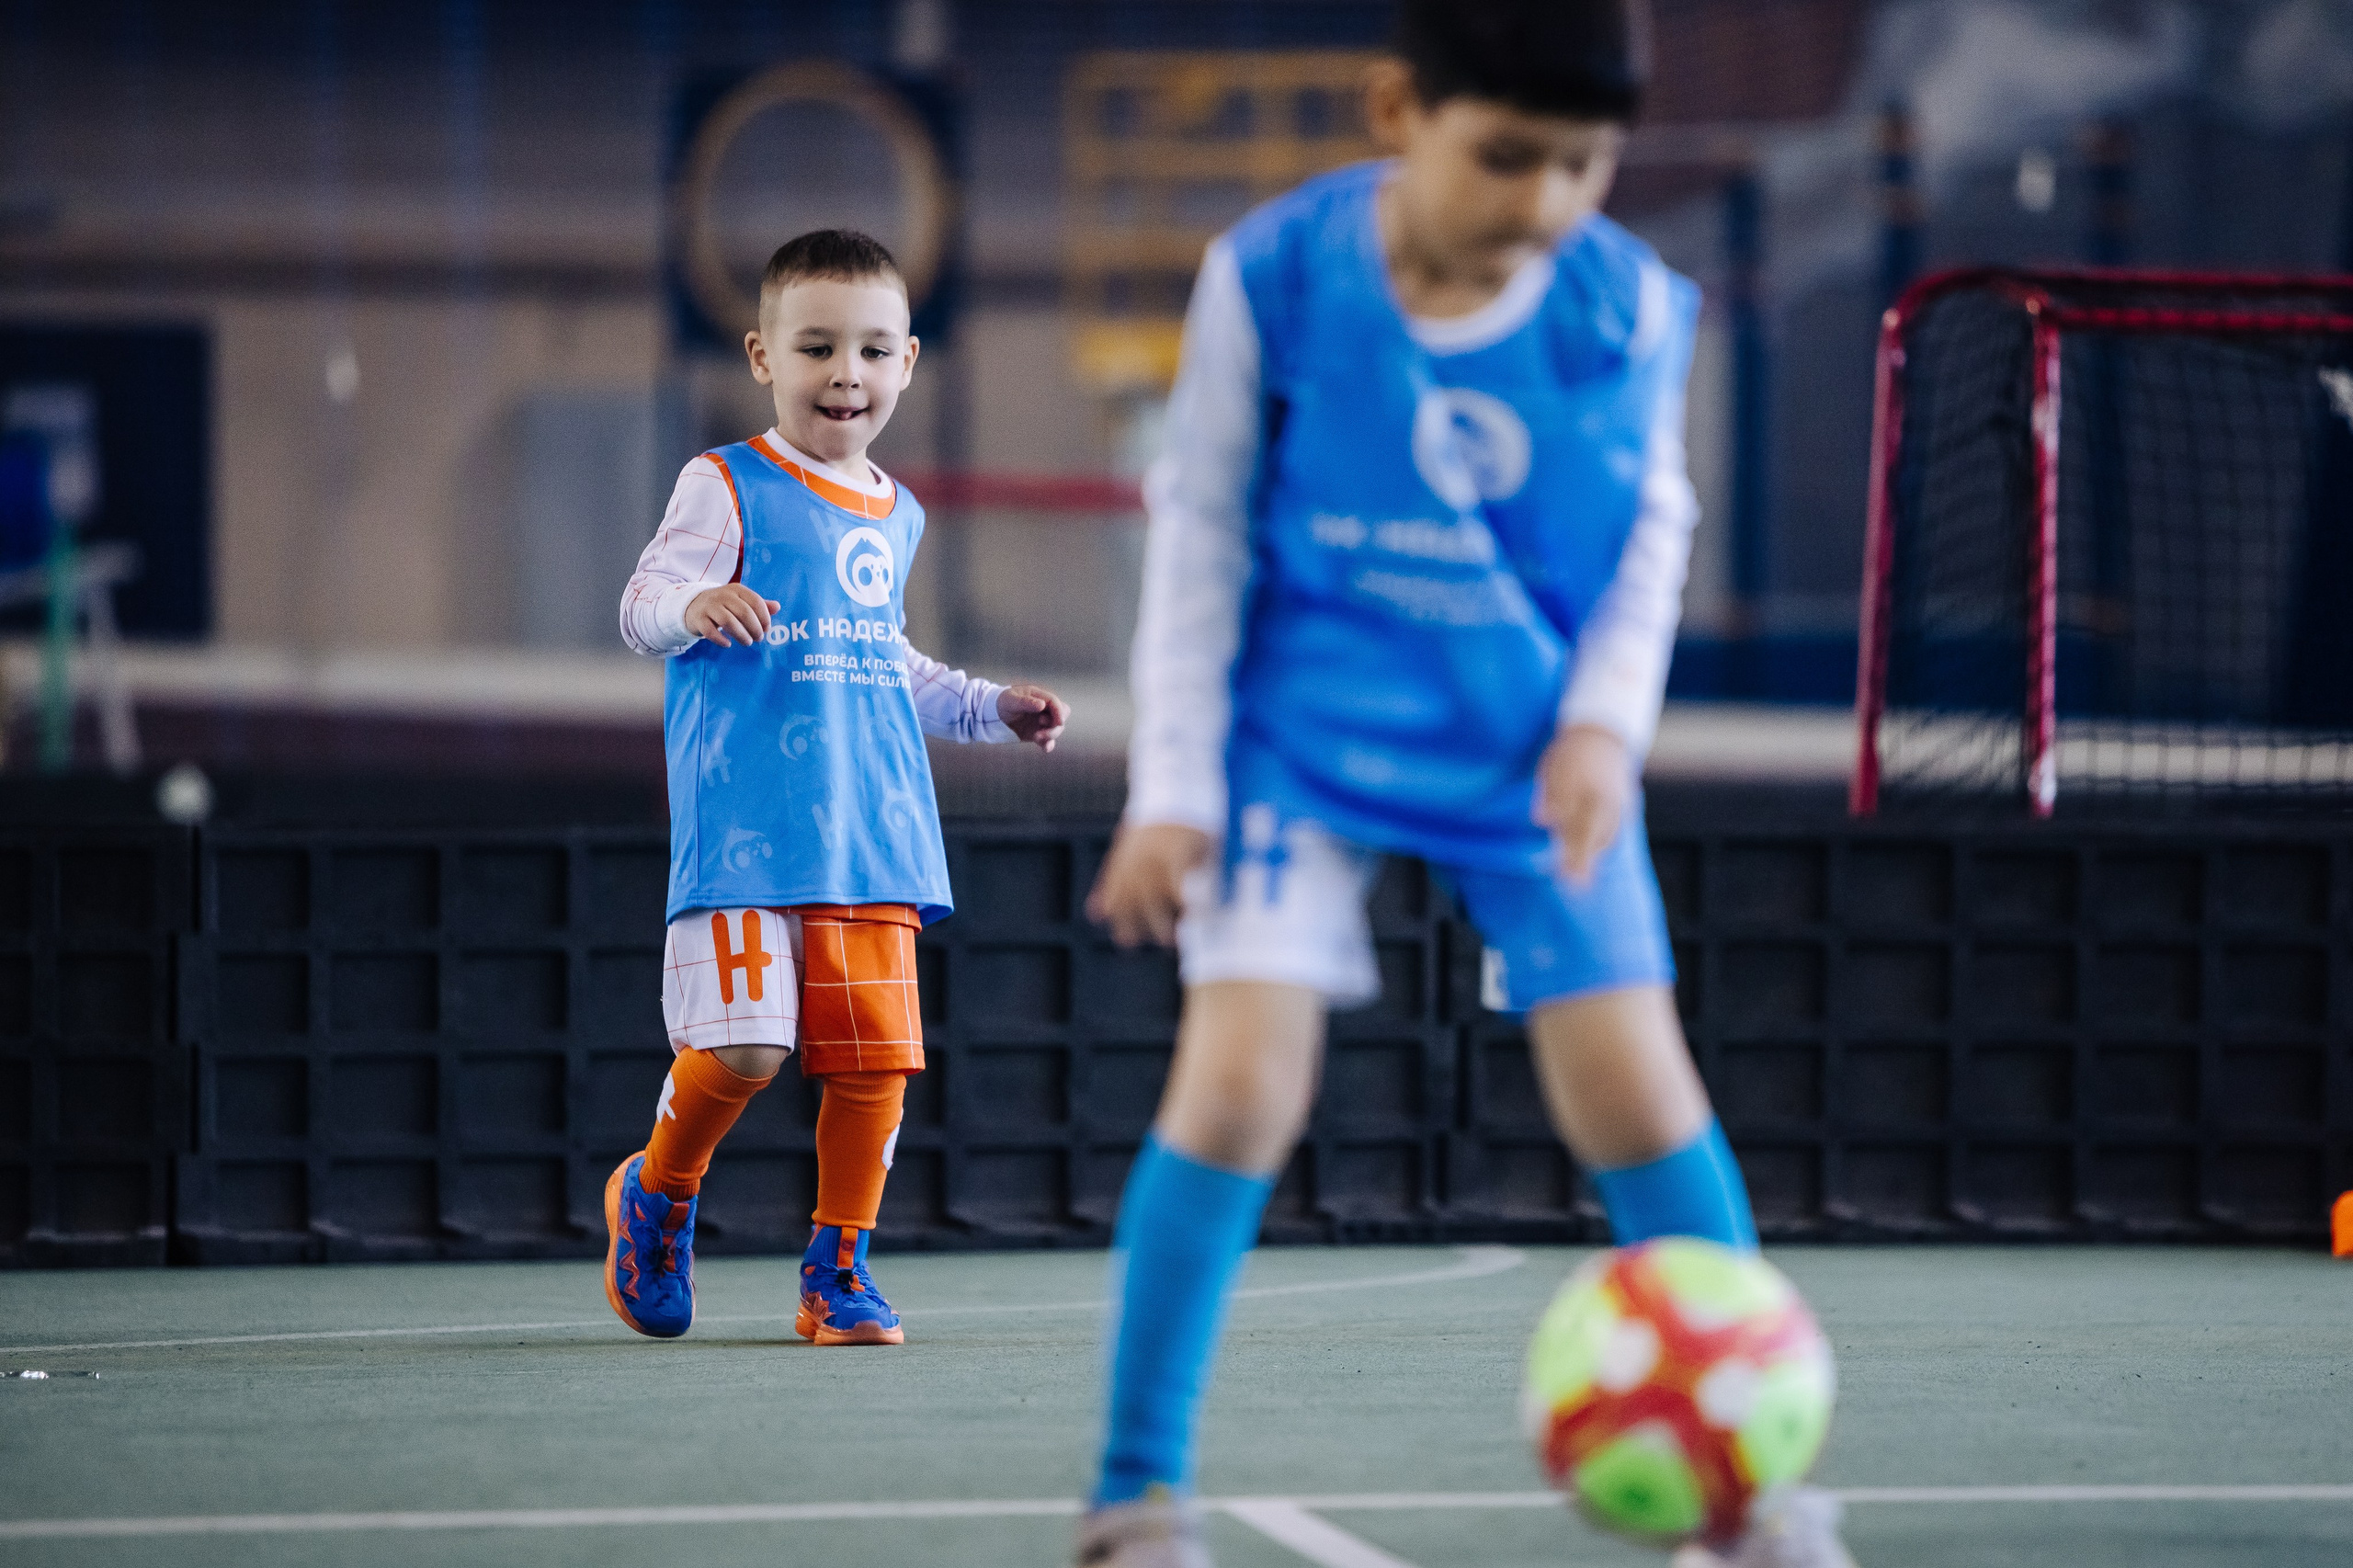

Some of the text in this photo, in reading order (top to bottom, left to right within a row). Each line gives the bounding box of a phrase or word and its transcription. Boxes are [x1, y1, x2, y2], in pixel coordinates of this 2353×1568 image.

[767, 619, 809, 645] ФК
[804, 653, 858, 670] ВПЕРЁД
[861, 657, 871, 669] К
[791, 670, 846, 682] ВМЕСТЕ
[849, 672, 875, 686] МЫ
